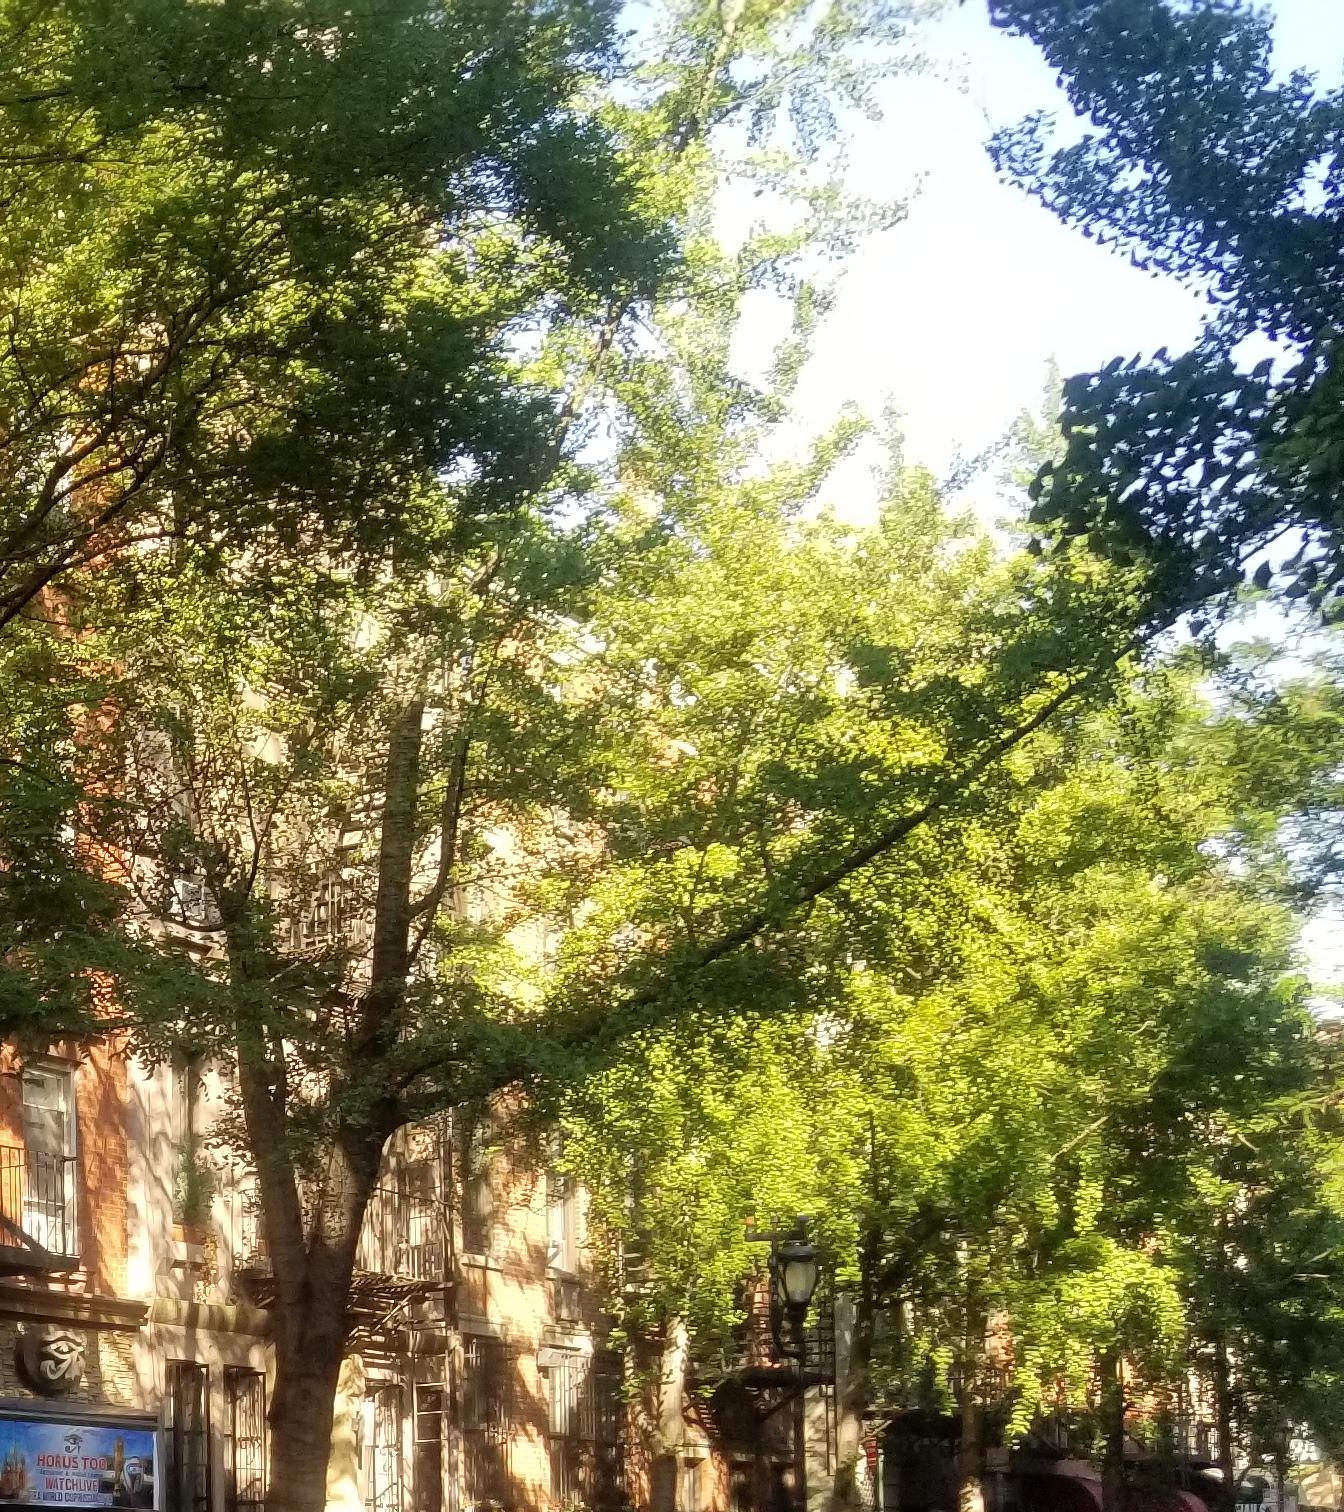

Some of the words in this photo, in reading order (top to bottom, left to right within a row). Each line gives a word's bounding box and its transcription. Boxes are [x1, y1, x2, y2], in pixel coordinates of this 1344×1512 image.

[37, 1454, 79, 1469] HORUS
[45, 1477, 79, 1492] WATCH
[80, 1478, 99, 1492] LIVE
